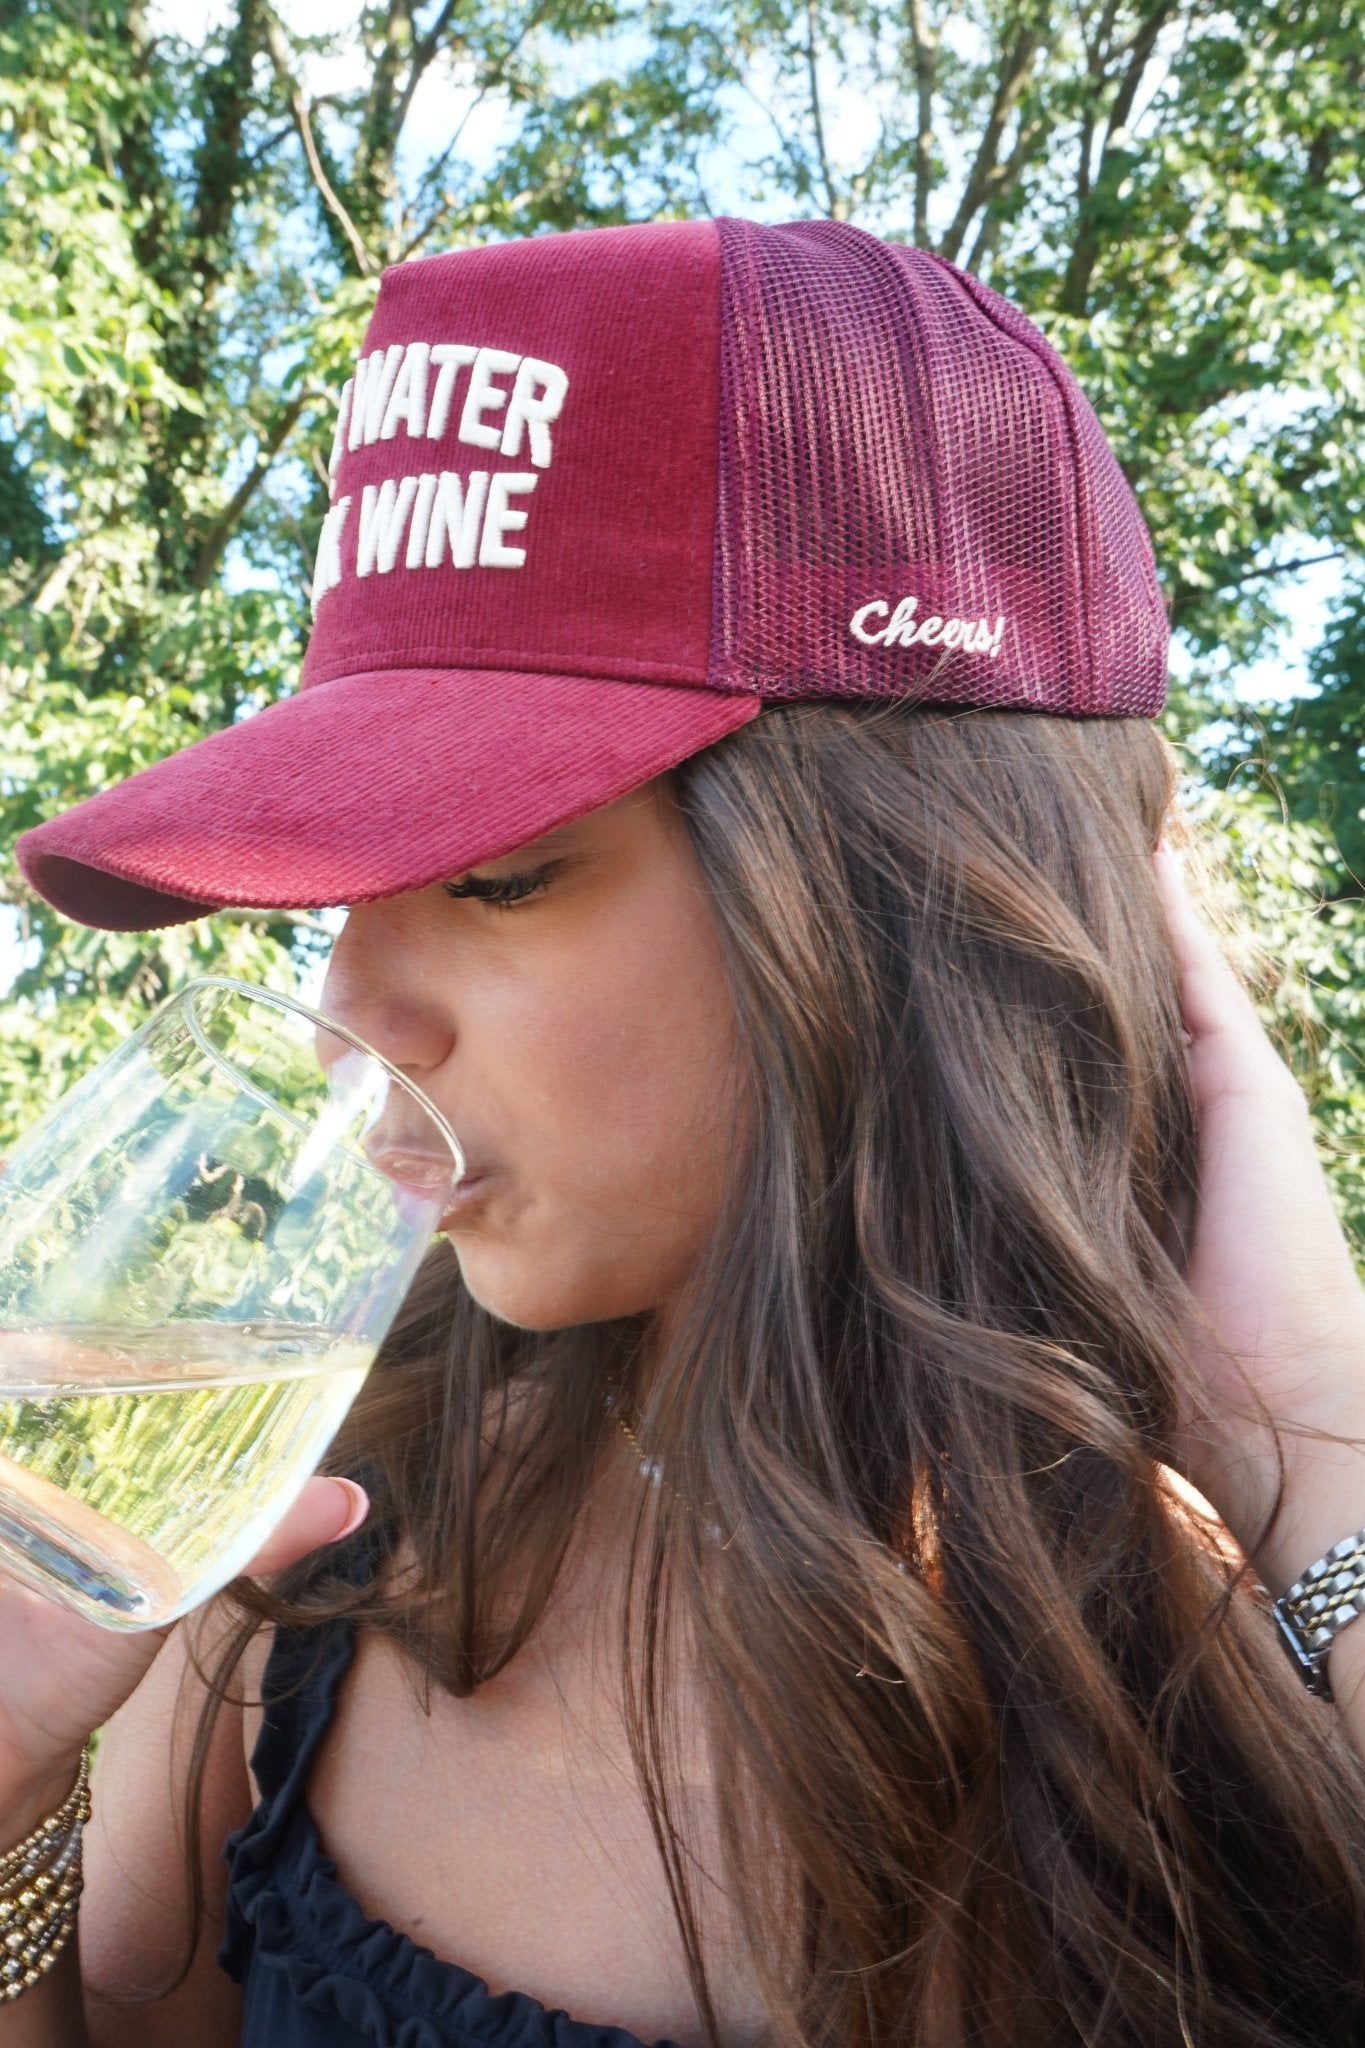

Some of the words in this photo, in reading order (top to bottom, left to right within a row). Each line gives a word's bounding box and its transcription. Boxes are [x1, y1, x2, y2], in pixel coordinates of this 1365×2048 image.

[348, 342, 569, 468] WATER
[356, 471, 538, 577] WINE
[850, 596, 1006, 658] Cheers!
